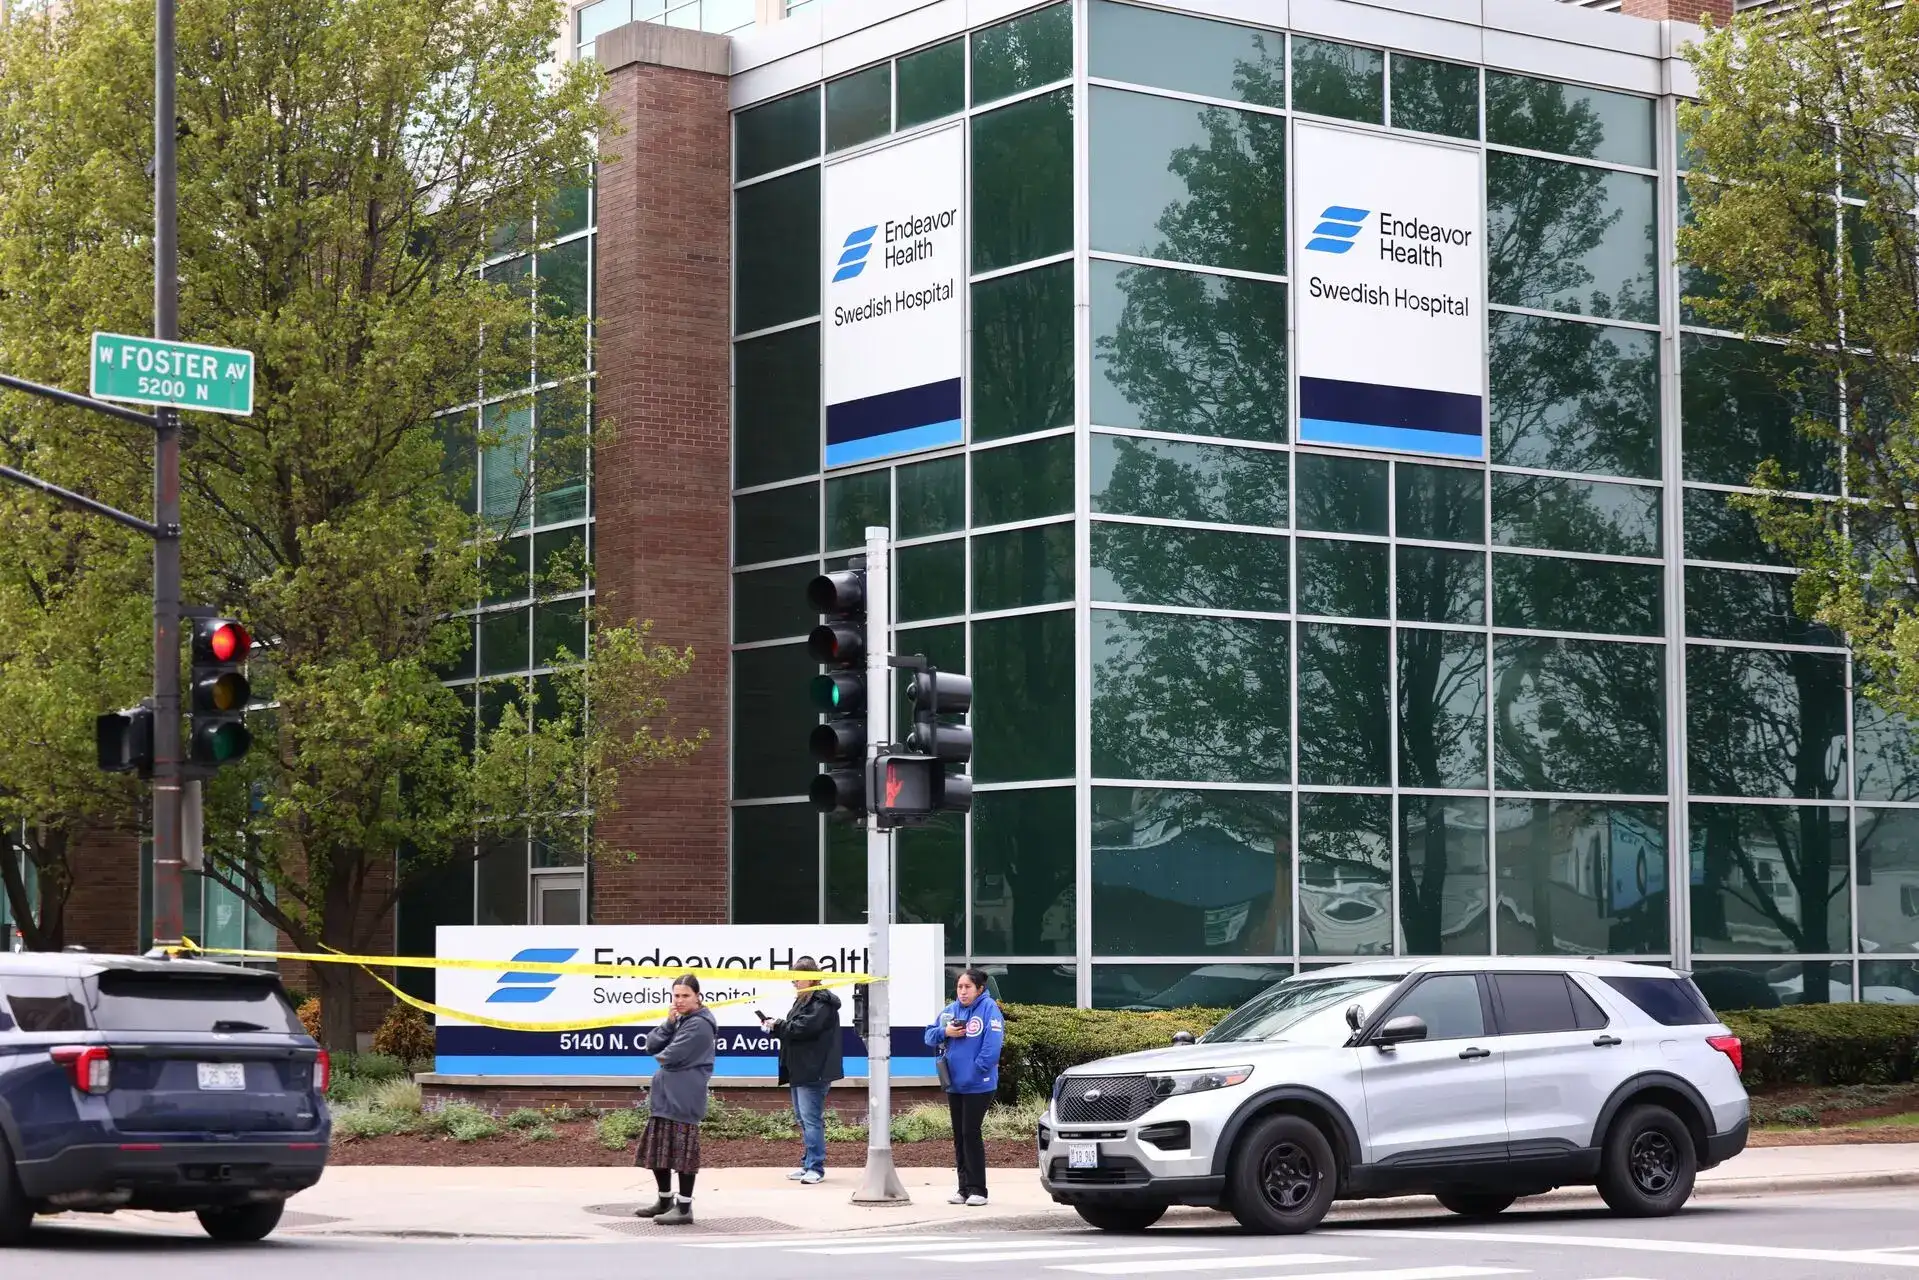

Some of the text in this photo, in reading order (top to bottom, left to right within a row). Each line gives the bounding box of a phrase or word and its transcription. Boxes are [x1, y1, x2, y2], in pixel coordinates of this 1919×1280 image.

[885, 208, 957, 244] Endeavor
[1380, 212, 1472, 246] Endeavor
[885, 237, 933, 269] Health
[1380, 238, 1443, 268] Health
[834, 278, 954, 327] Swedish Hospital
[1309, 276, 1469, 317] Swedish Hospital
[100, 346, 247, 380] W FOSTER AV
[138, 376, 208, 400] 5200 N
[593, 987, 673, 1004] Swedish
[560, 1033, 604, 1050] 5140
[609, 1033, 628, 1050] N.
[732, 1033, 781, 1050] Aven
